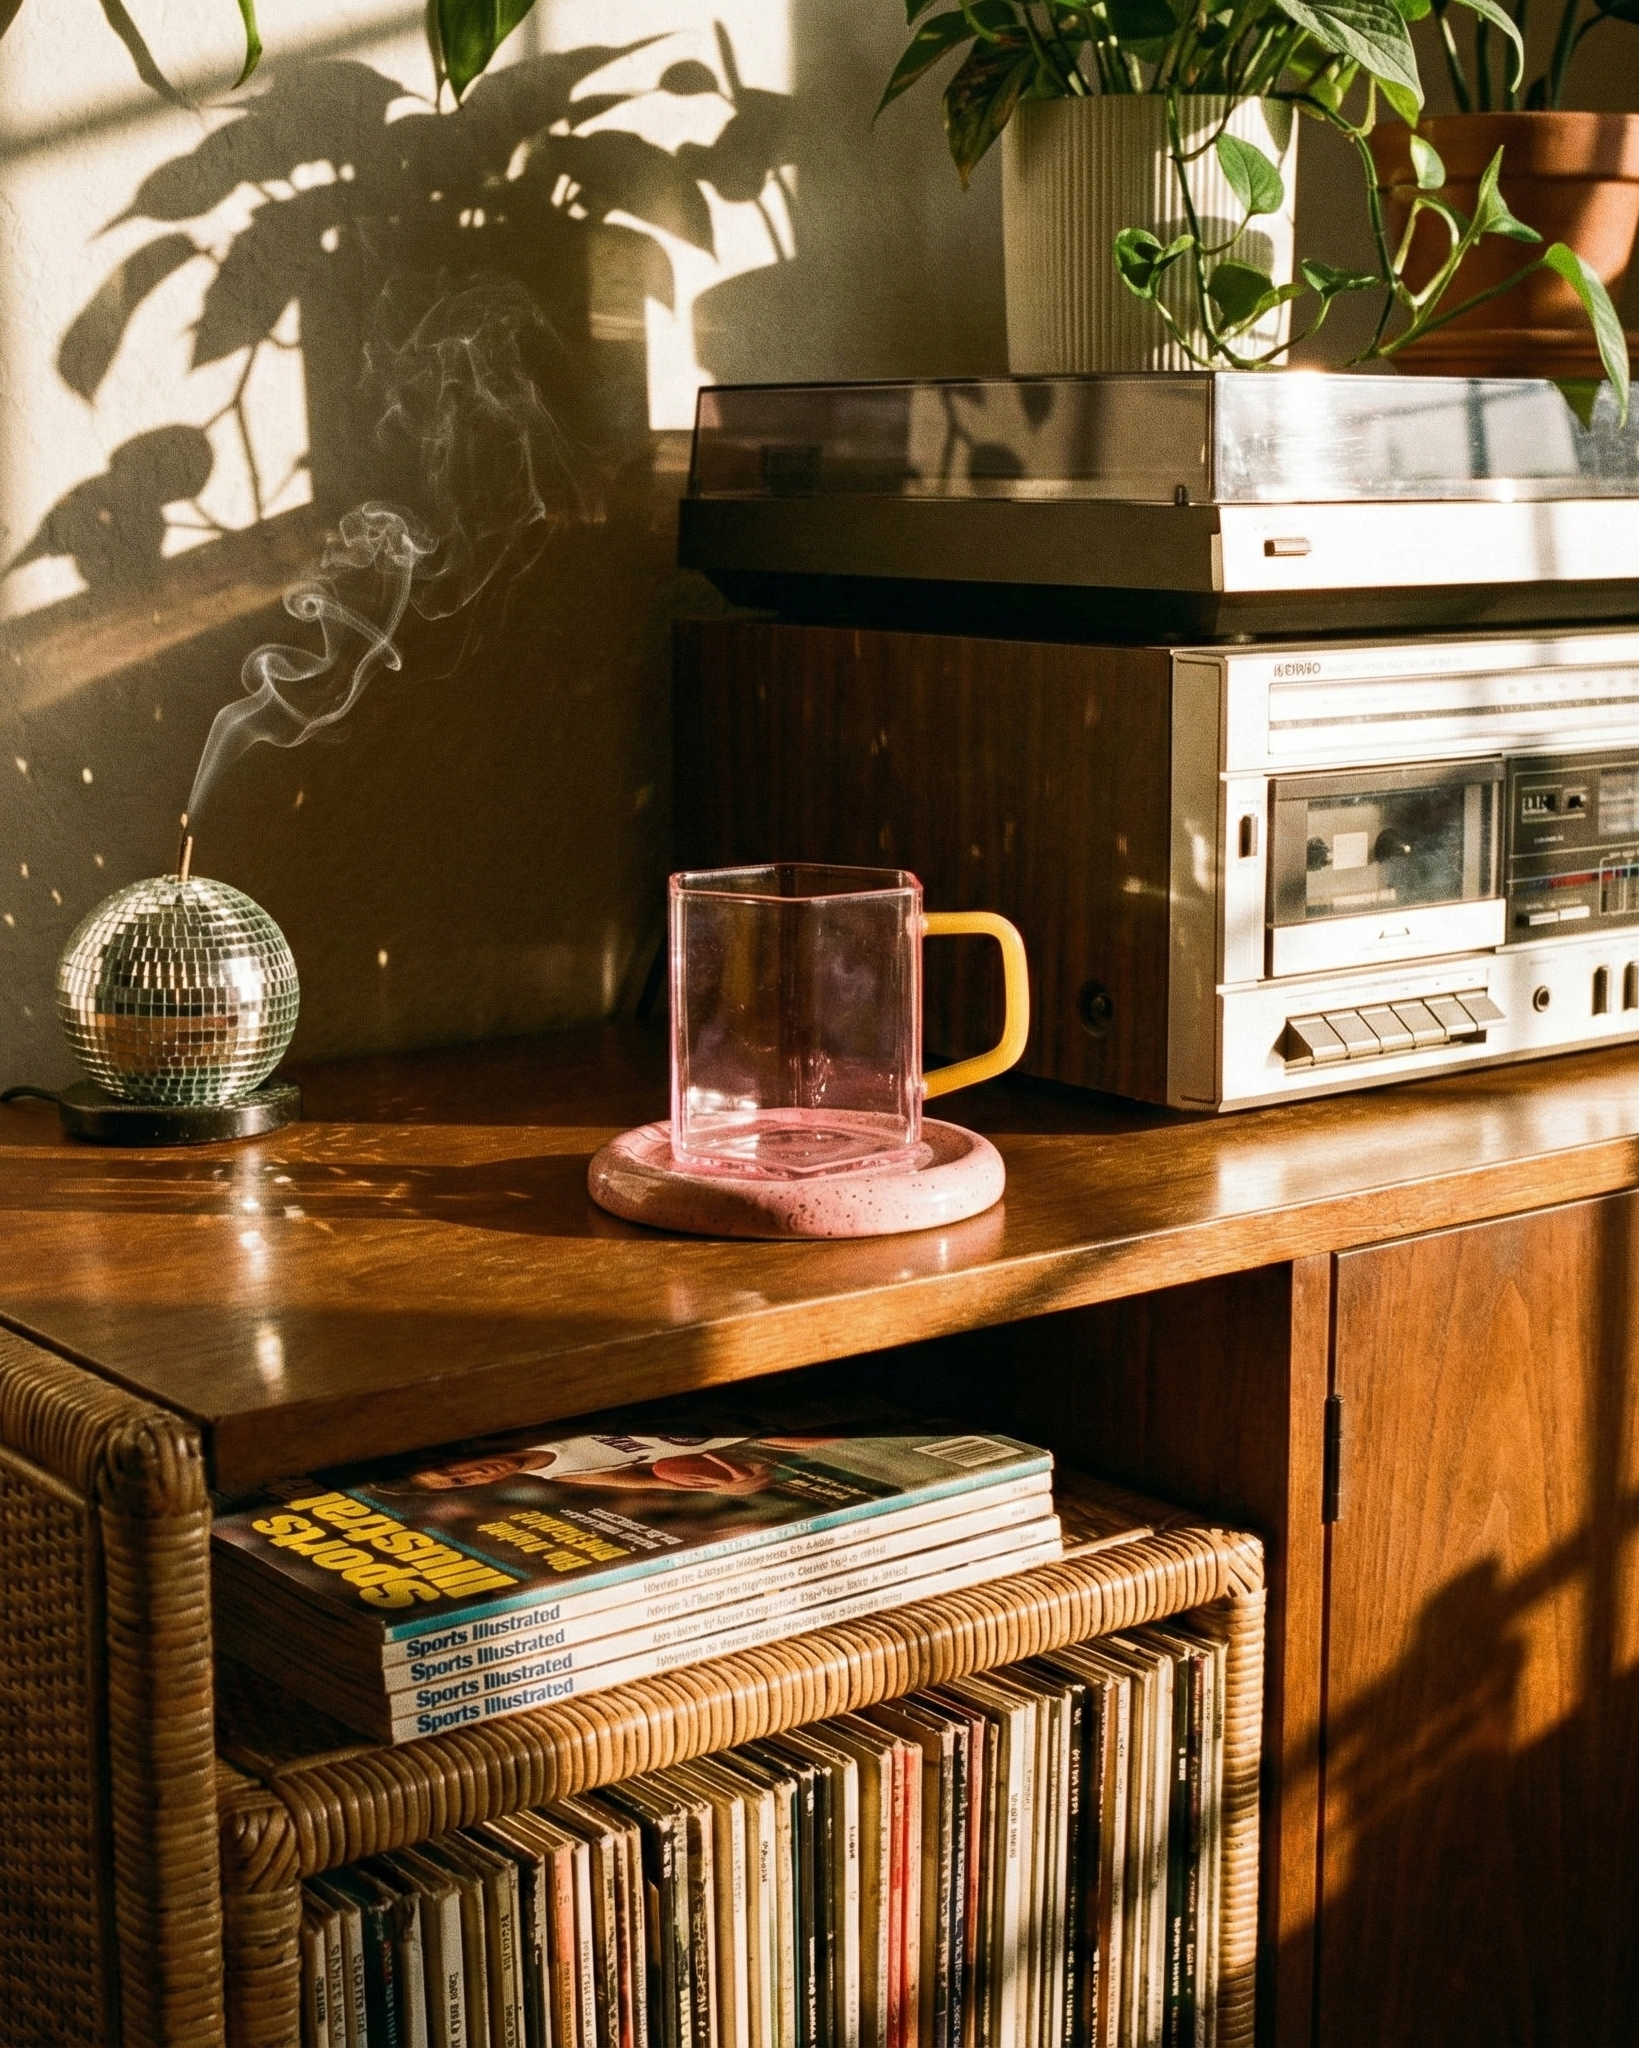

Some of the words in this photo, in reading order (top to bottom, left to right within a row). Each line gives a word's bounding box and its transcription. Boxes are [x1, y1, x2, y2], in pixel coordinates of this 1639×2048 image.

[252, 1514, 441, 1609] Sports
[281, 1491, 519, 1599] Illustrat
[406, 1630, 468, 1659] Sports
[472, 1604, 560, 1641] Illustrated
[410, 1654, 473, 1682] Sports
[477, 1628, 565, 1665] Illustrated
[416, 1680, 479, 1708] Sports
[483, 1652, 573, 1690] Illustrated
[417, 1704, 480, 1733] Sports
[484, 1677, 574, 1715] Illustrated
